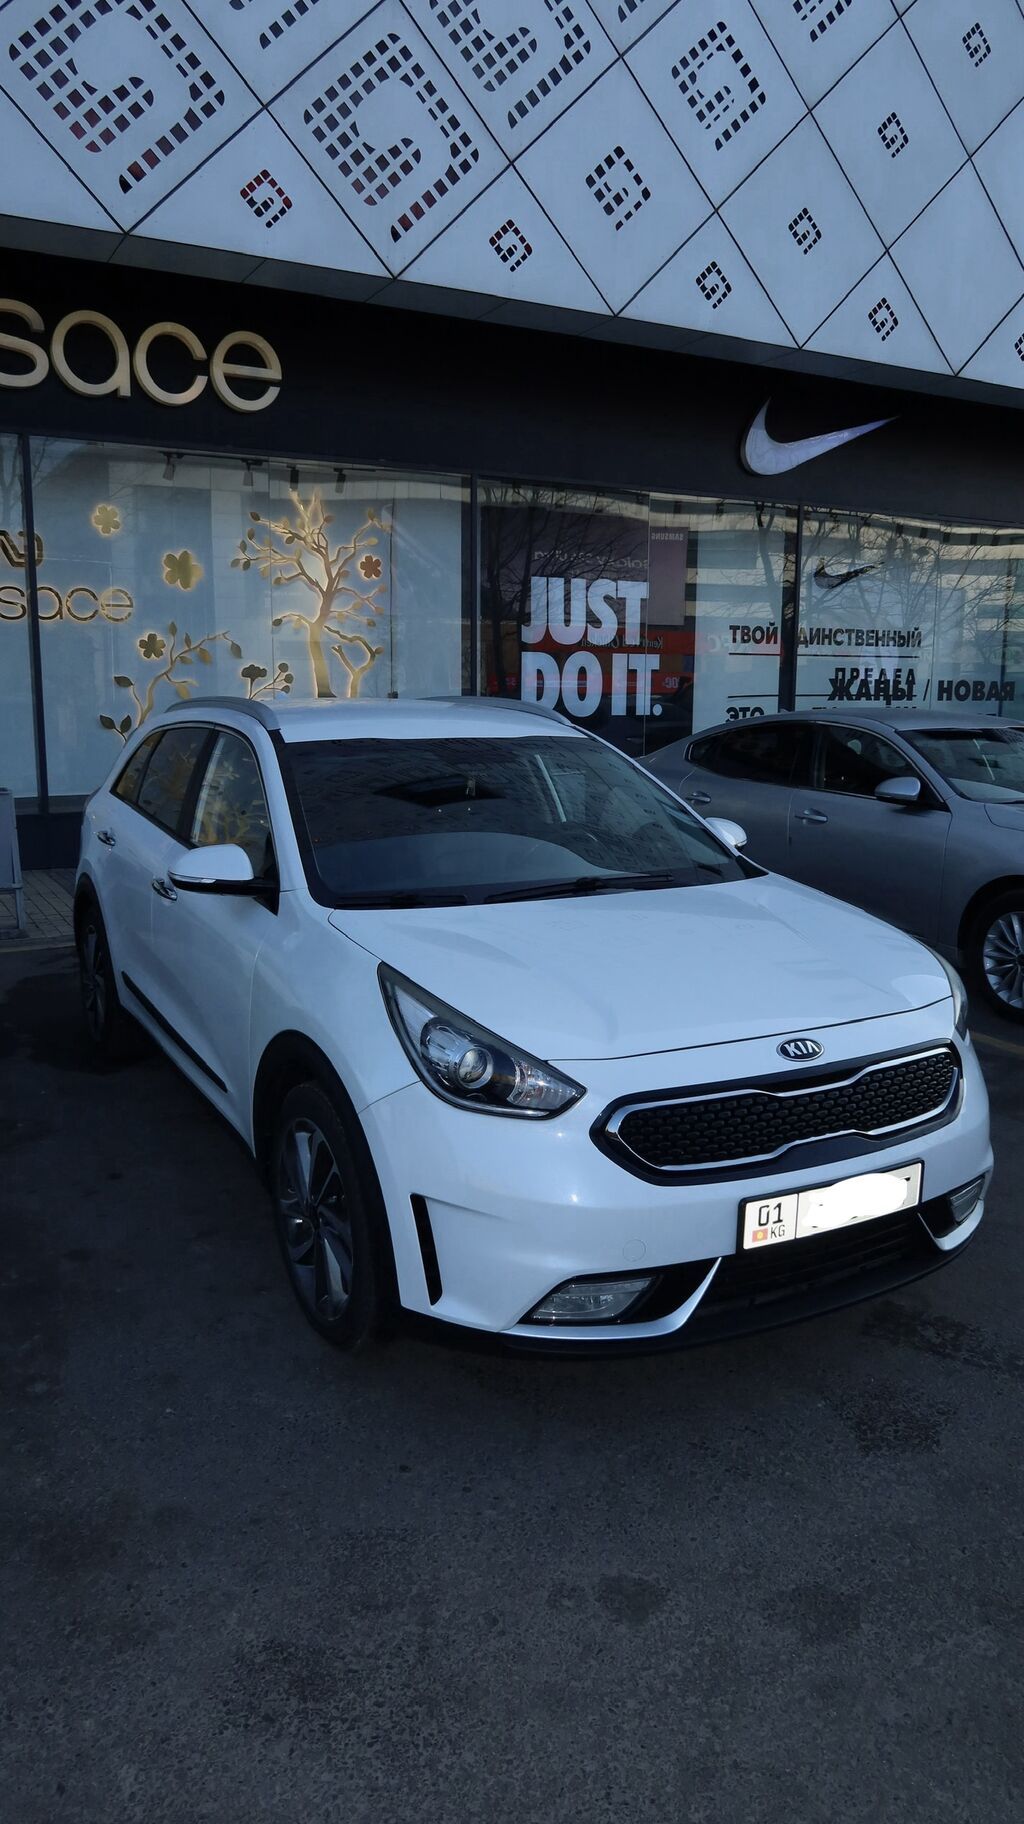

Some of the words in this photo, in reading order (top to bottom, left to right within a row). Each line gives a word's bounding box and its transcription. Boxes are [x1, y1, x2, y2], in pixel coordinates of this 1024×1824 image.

[0, 298, 282, 413] sace
[521, 576, 649, 645] JUST
[729, 621, 778, 645] ТВОЙ
[796, 626, 922, 648] ДИНСТВЕННЫЙ
[521, 651, 603, 717] DO
[611, 653, 663, 716] IT.
[937, 680, 1015, 701] НОВАЯ
[783, 1040, 820, 1057] KIA
[758, 1202, 783, 1227] 01
[770, 1224, 786, 1239] KG
